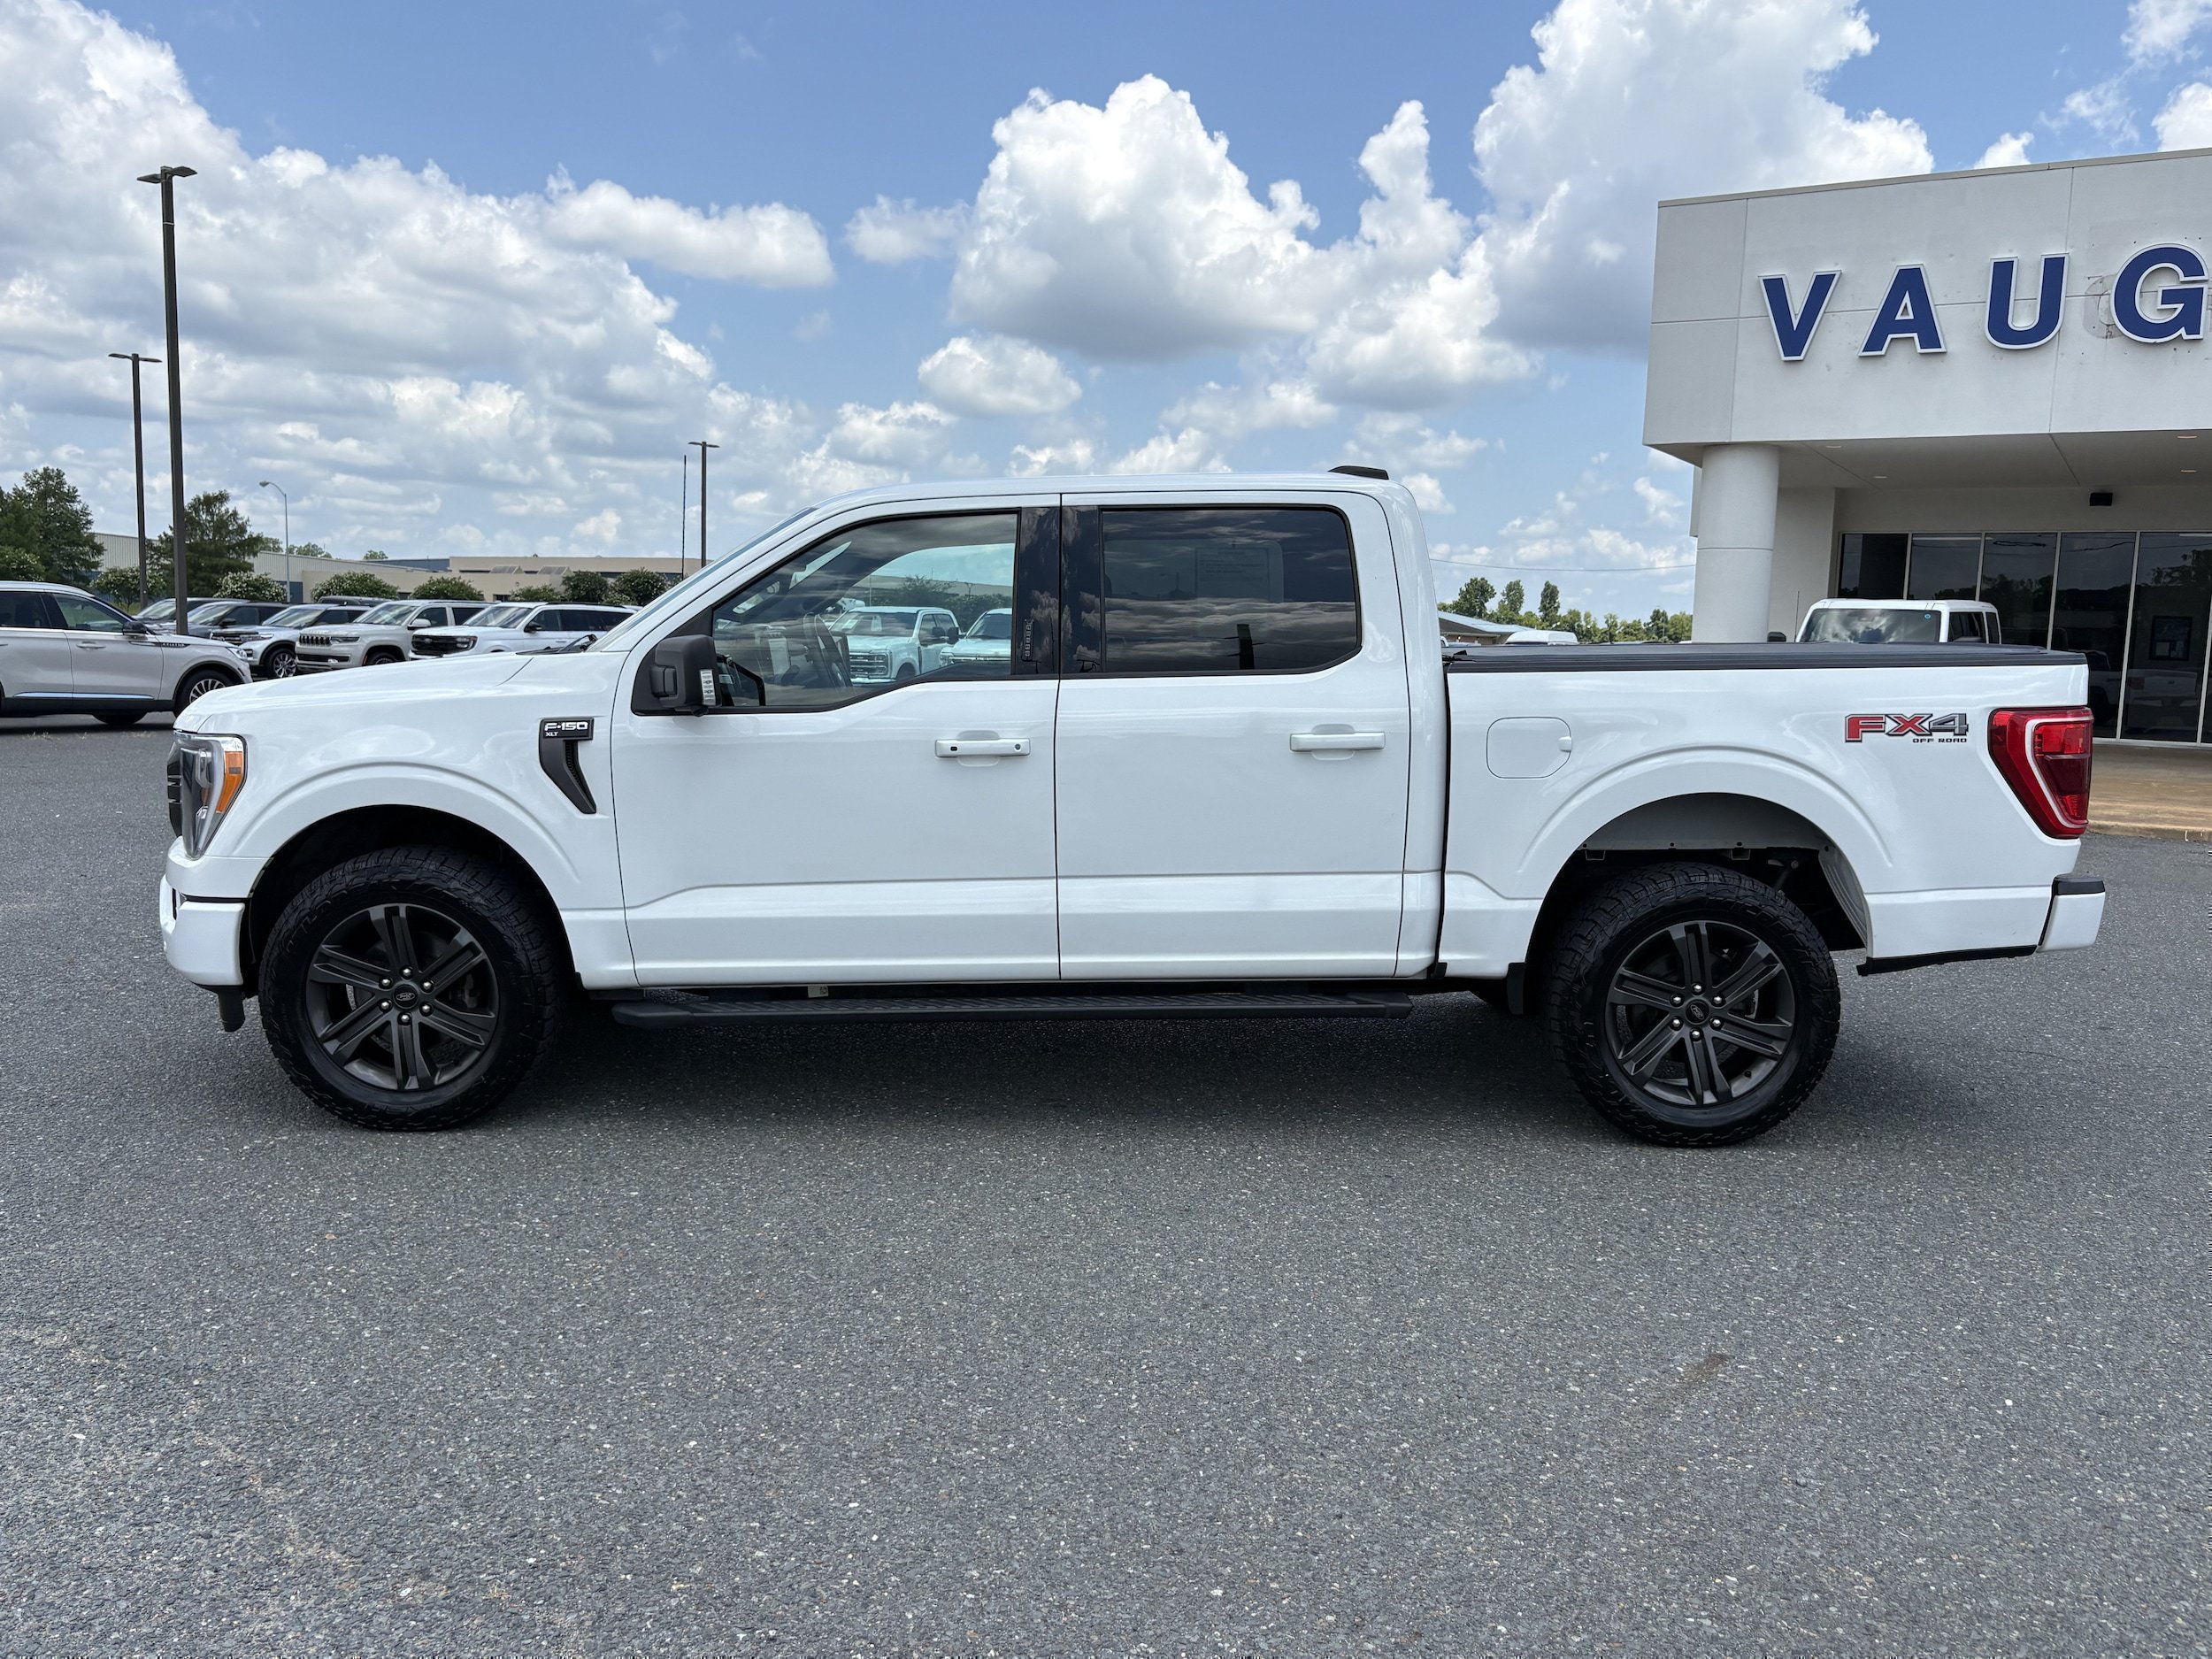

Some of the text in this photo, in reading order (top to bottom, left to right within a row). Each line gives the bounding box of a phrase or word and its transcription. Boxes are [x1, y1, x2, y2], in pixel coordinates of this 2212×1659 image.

[1758, 242, 2209, 361] VAUG
[544, 721, 588, 731] F-150
[1845, 713, 1969, 742] FX4
